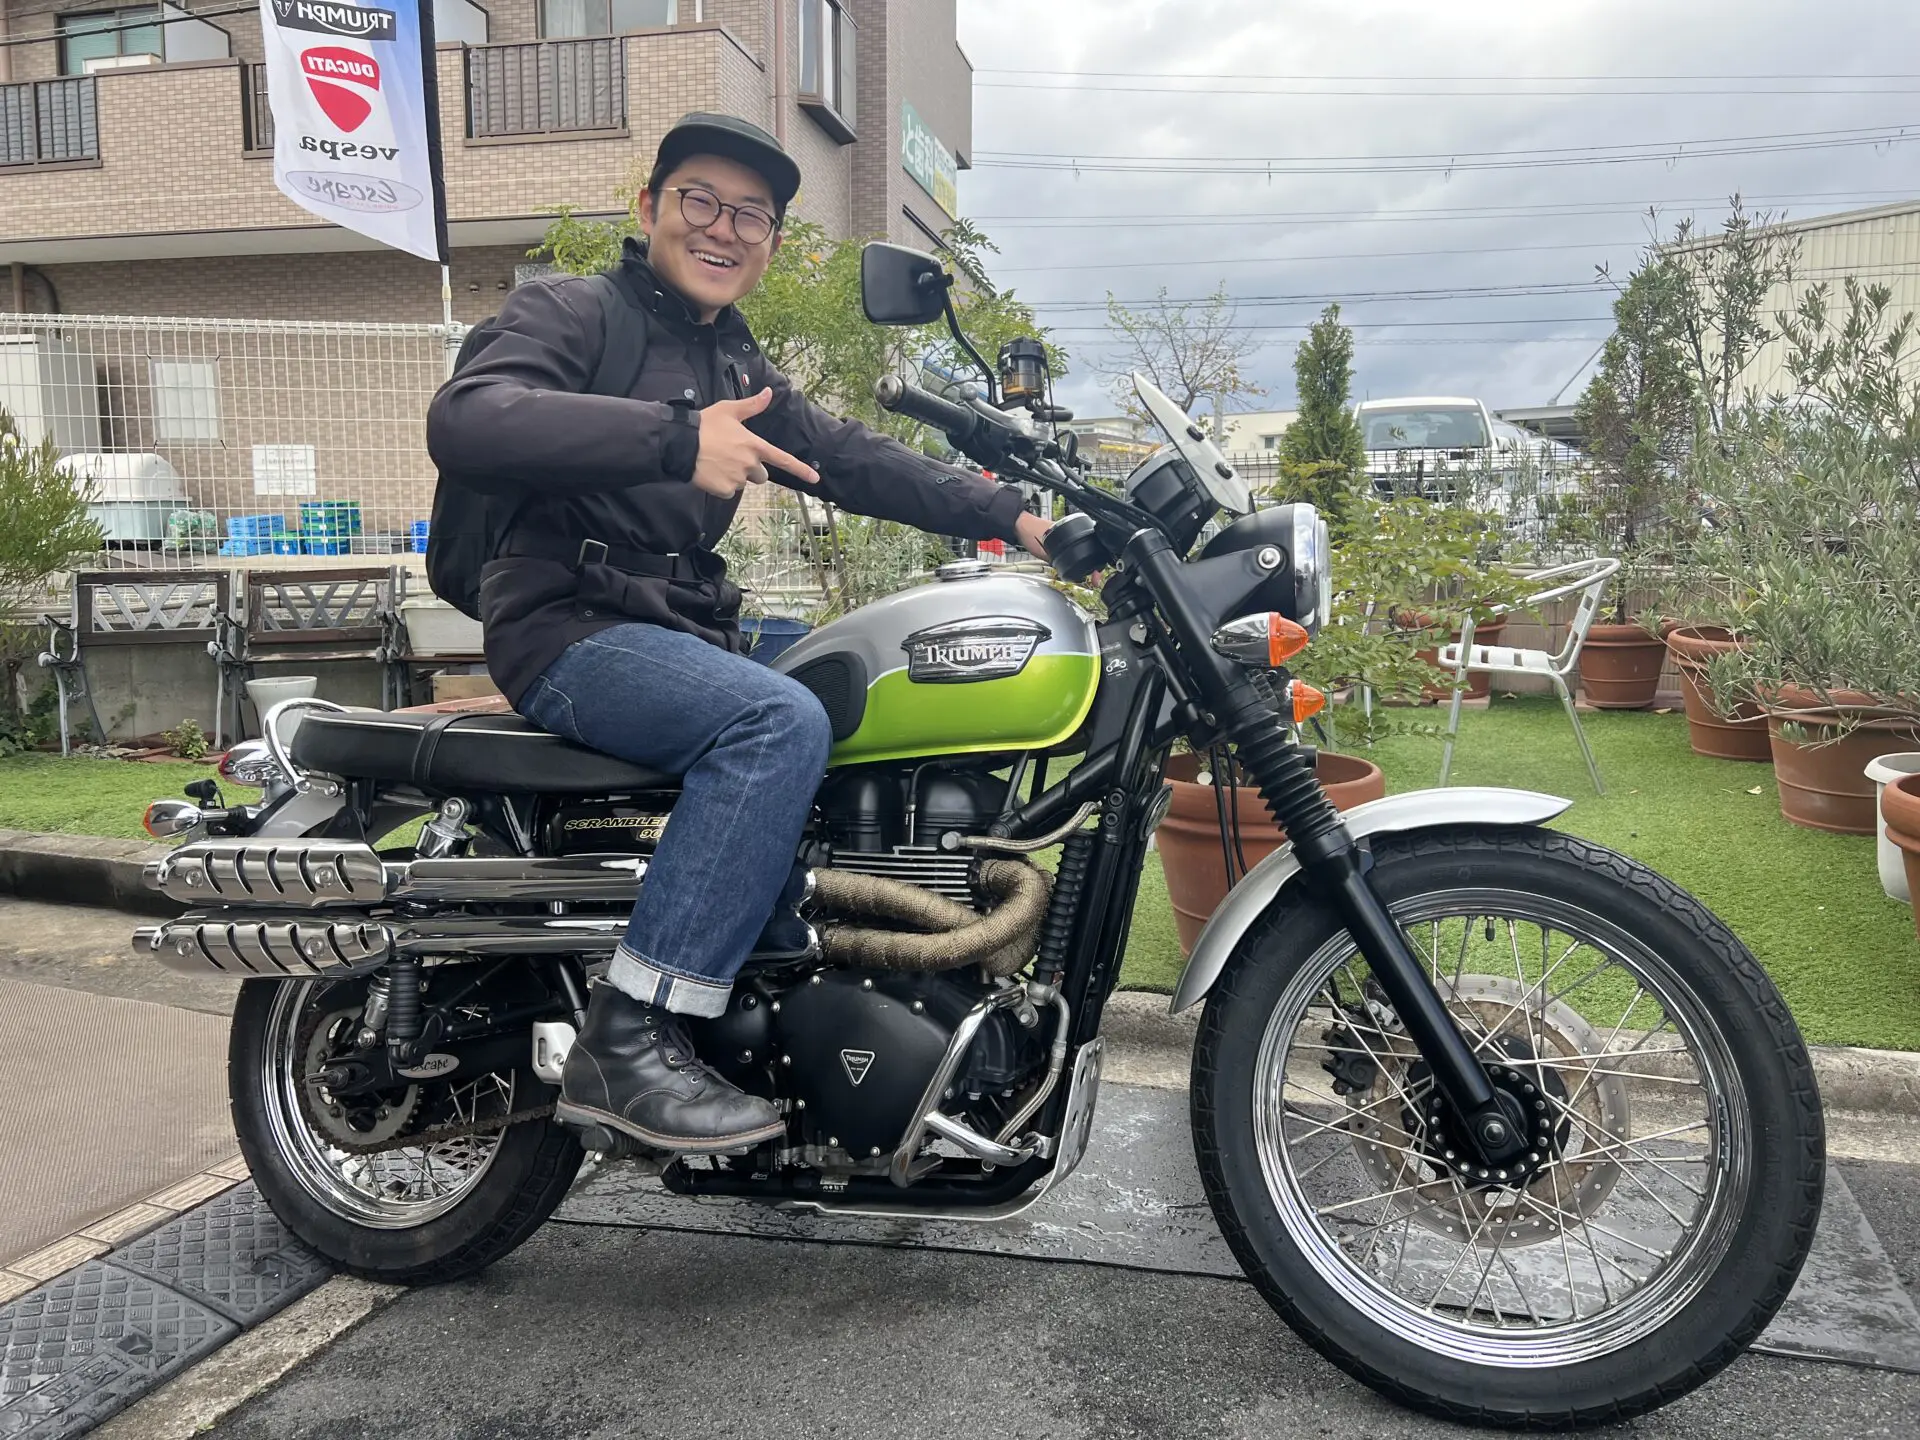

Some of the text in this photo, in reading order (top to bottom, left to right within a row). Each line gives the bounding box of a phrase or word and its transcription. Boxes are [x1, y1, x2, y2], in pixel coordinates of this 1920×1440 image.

[902, 114, 934, 189] と歯科
[922, 644, 1015, 670] TRIUMPH
